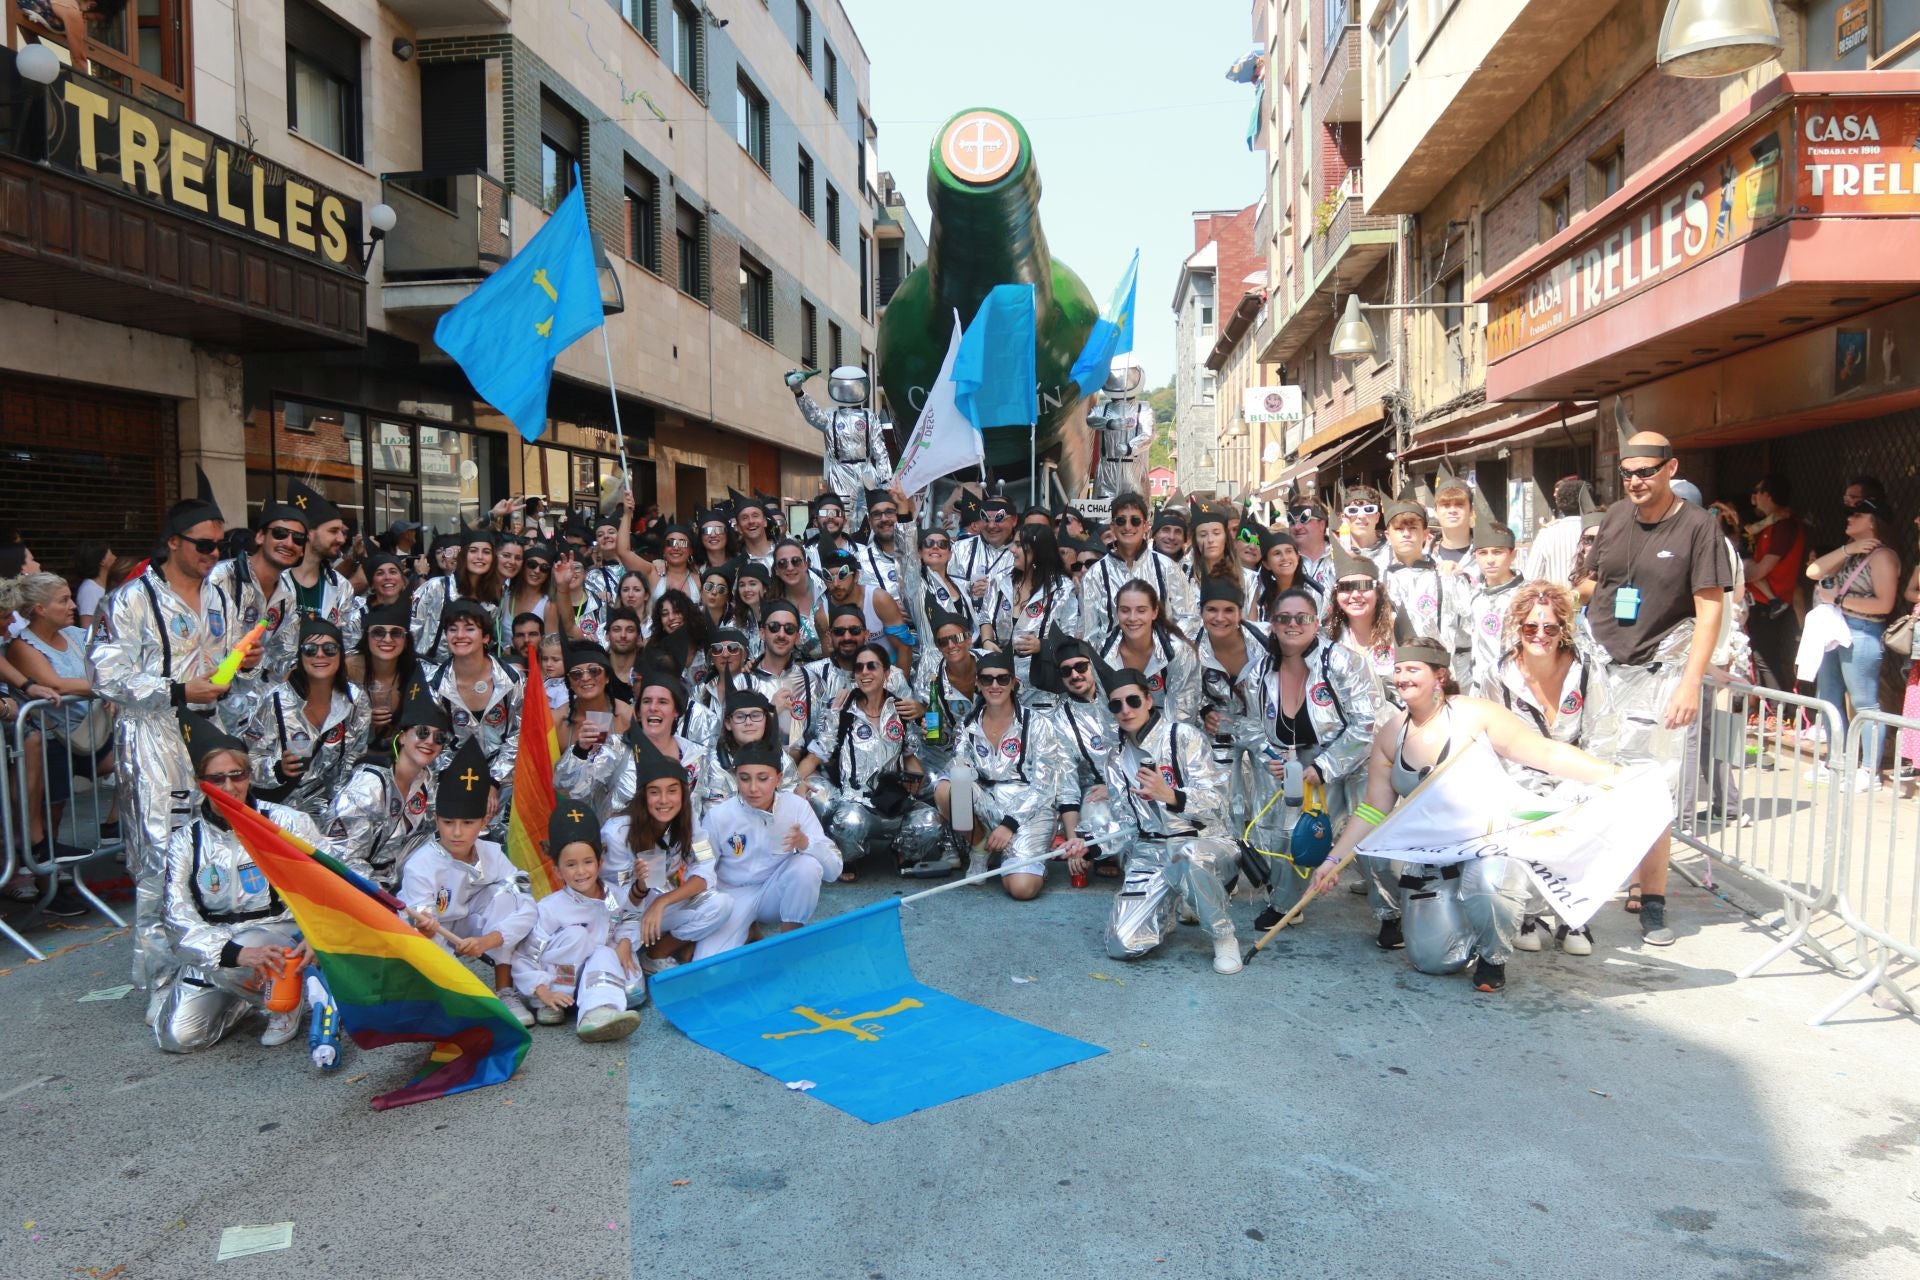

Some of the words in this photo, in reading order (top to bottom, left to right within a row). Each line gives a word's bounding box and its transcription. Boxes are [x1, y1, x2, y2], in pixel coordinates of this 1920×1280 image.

[1805, 115, 1880, 142] CASA
[1807, 147, 1846, 156] FUNDADA
[1860, 146, 1881, 155] 1910
[64, 80, 348, 263] TRELLES
[1528, 268, 1562, 318] CASA
[1567, 181, 1708, 318] TRELLES
[1250, 412, 1299, 422] BUNKAI
